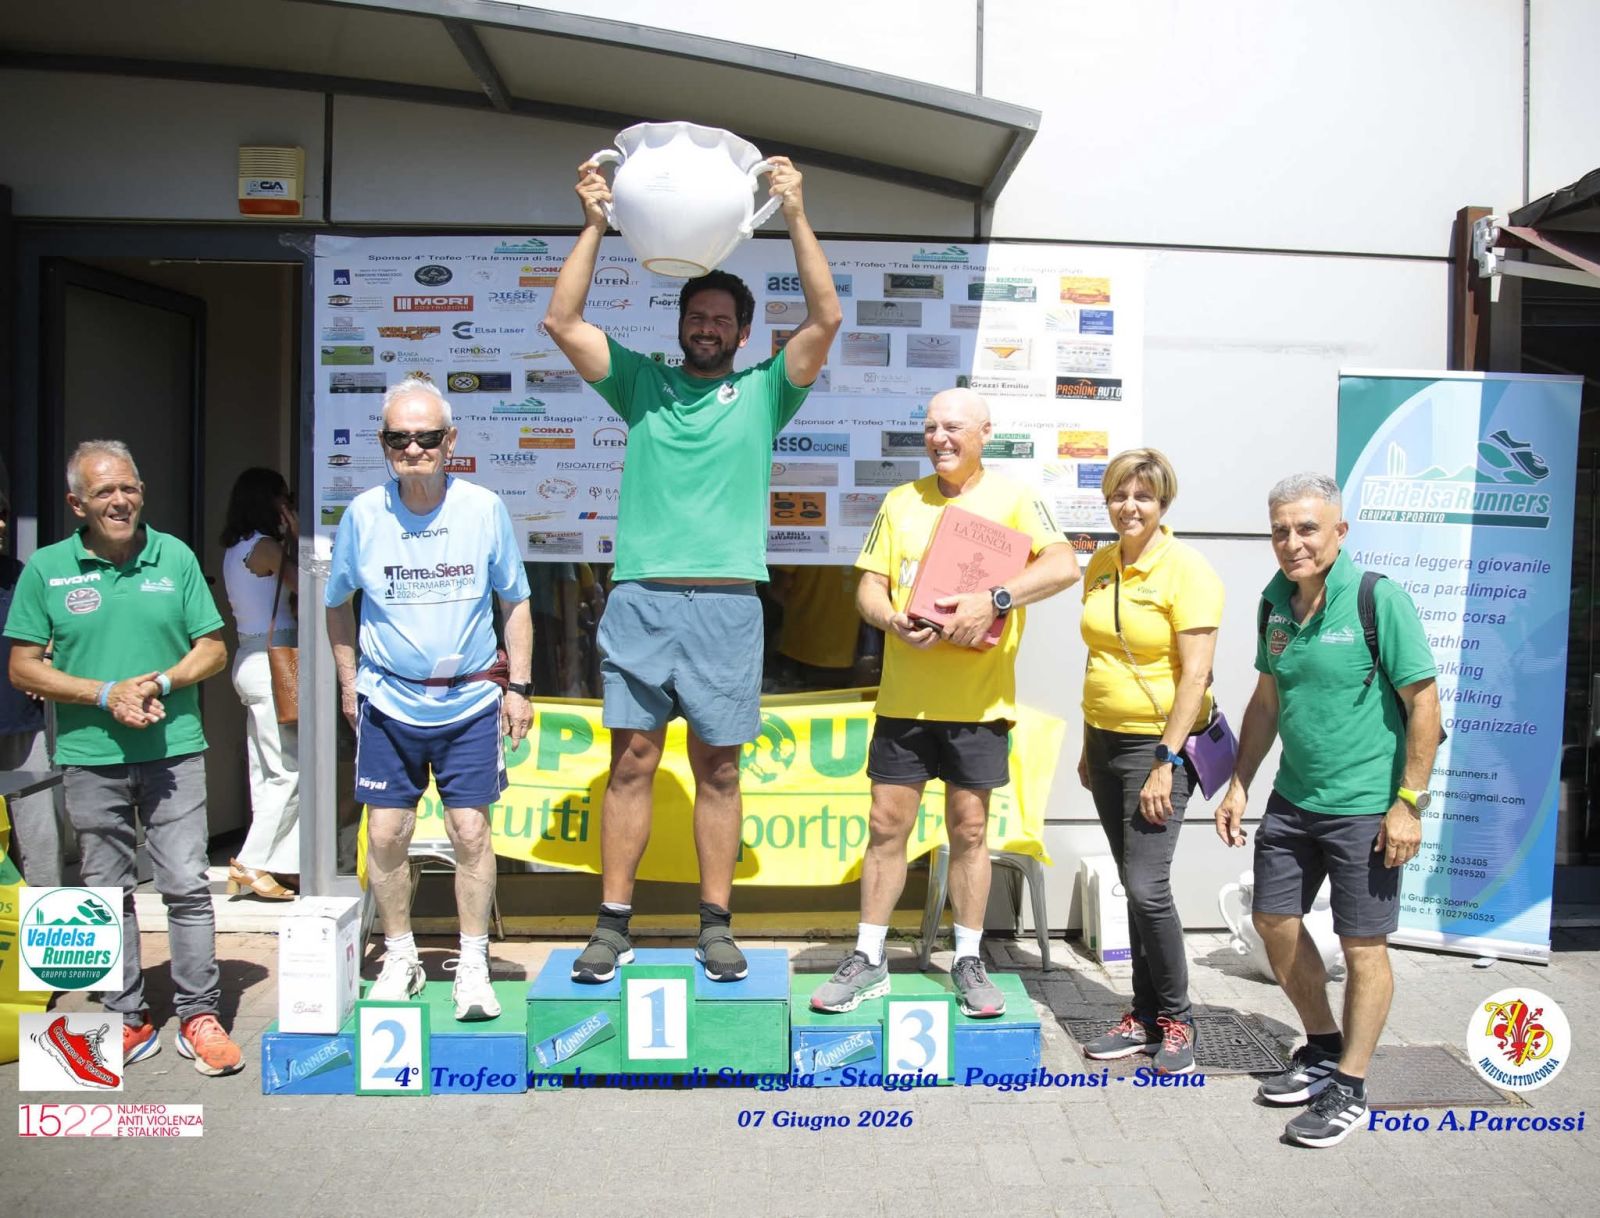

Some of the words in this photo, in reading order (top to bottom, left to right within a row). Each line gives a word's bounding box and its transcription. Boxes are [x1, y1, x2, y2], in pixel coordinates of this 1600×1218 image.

[368, 254, 413, 262] Sponsor
[767, 276, 801, 292] ass
[414, 297, 469, 306] MORI
[475, 326, 498, 334] Elsa
[500, 326, 525, 334] Laser
[449, 347, 501, 355] TERMOSAN
[794, 418, 836, 426] Sponsor
[593, 438, 627, 447] UTEN
[444, 458, 471, 467] ORI
[502, 488, 526, 496] Laser
[1361, 481, 1551, 515] ValdelsaRunners
[1361, 509, 1396, 522] GRUPPO
[1400, 511, 1446, 523] SPORTIVO
[401, 527, 449, 540] GIVOVA
[970, 521, 1006, 539] FATTORIA
[953, 522, 968, 536] LA
[972, 527, 1012, 553] TANCIA
[1352, 551, 1411, 567] Atletica
[1415, 554, 1473, 572] leggera
[1478, 558, 1551, 574] giovanile
[395, 577, 476, 591] ULTRAMARATHON
[1403, 580, 1430, 594] tica
[1433, 583, 1527, 601] paralimpica
[396, 591, 417, 599] 2026
[1462, 611, 1506, 625] corsa
[1427, 633, 1480, 650] iathlon
[1437, 662, 1484, 681] alking
[1439, 687, 1502, 709] Walking
[1445, 717, 1538, 736] organizzate
[1431, 767, 1498, 780] elsarunners.it
[359, 777, 387, 790] Royal
[1430, 788, 1526, 806] nners@gmail.com
[1420, 808, 1440, 819] elsa
[1442, 812, 1480, 823] runners
[1430, 853, 1447, 862] 329
[1449, 855, 1488, 867] 3633405
[1428, 865, 1445, 874] 347
[1446, 867, 1486, 879] 0949520
[1408, 893, 1442, 905] Gruppo
[1443, 897, 1479, 909] Sportivo
[1435, 908, 1496, 922] 91027950525
[641, 986, 676, 1049] 1
[897, 1008, 937, 1071] 3
[371, 1019, 407, 1079] 2
